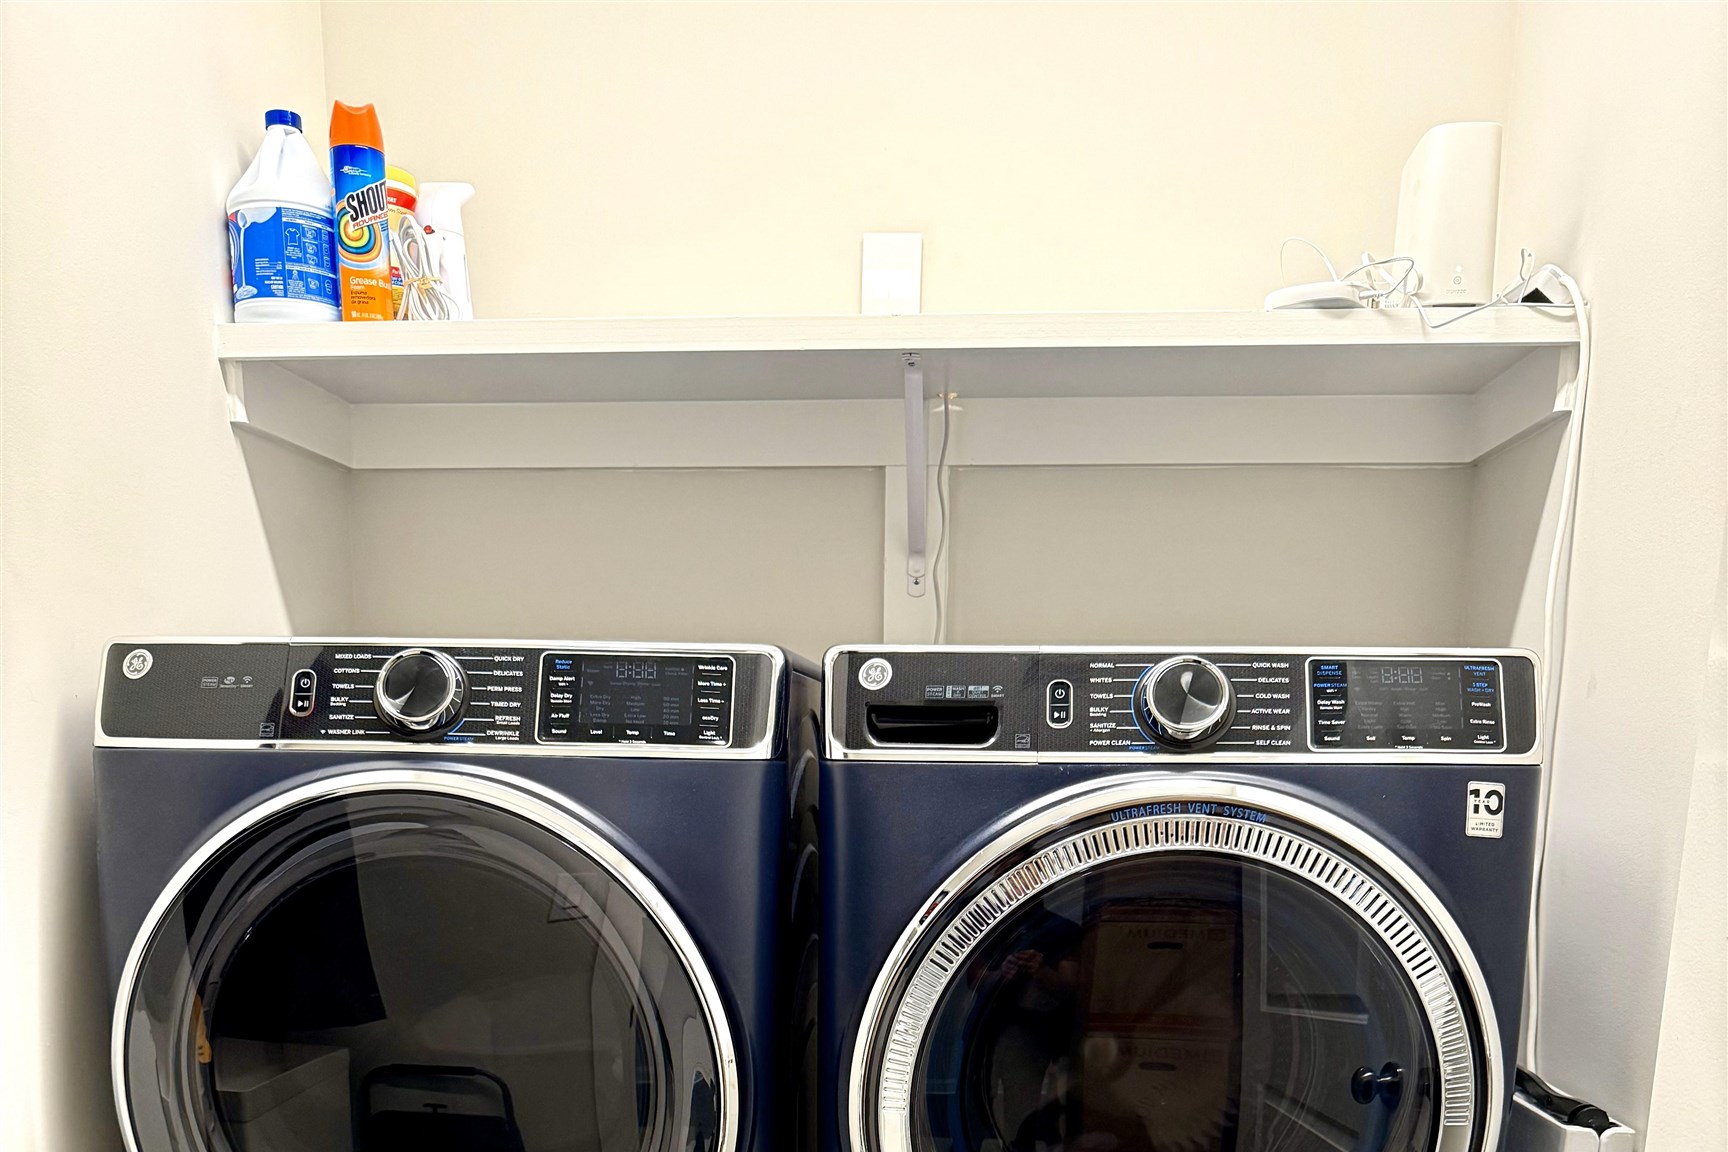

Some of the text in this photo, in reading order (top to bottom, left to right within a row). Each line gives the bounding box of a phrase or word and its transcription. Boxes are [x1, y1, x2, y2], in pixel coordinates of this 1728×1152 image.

[350, 276, 377, 286] Grease
[1470, 789, 1503, 815] 10
[1111, 803, 1267, 823] ULTRAFRESH VENT SYSTEM
